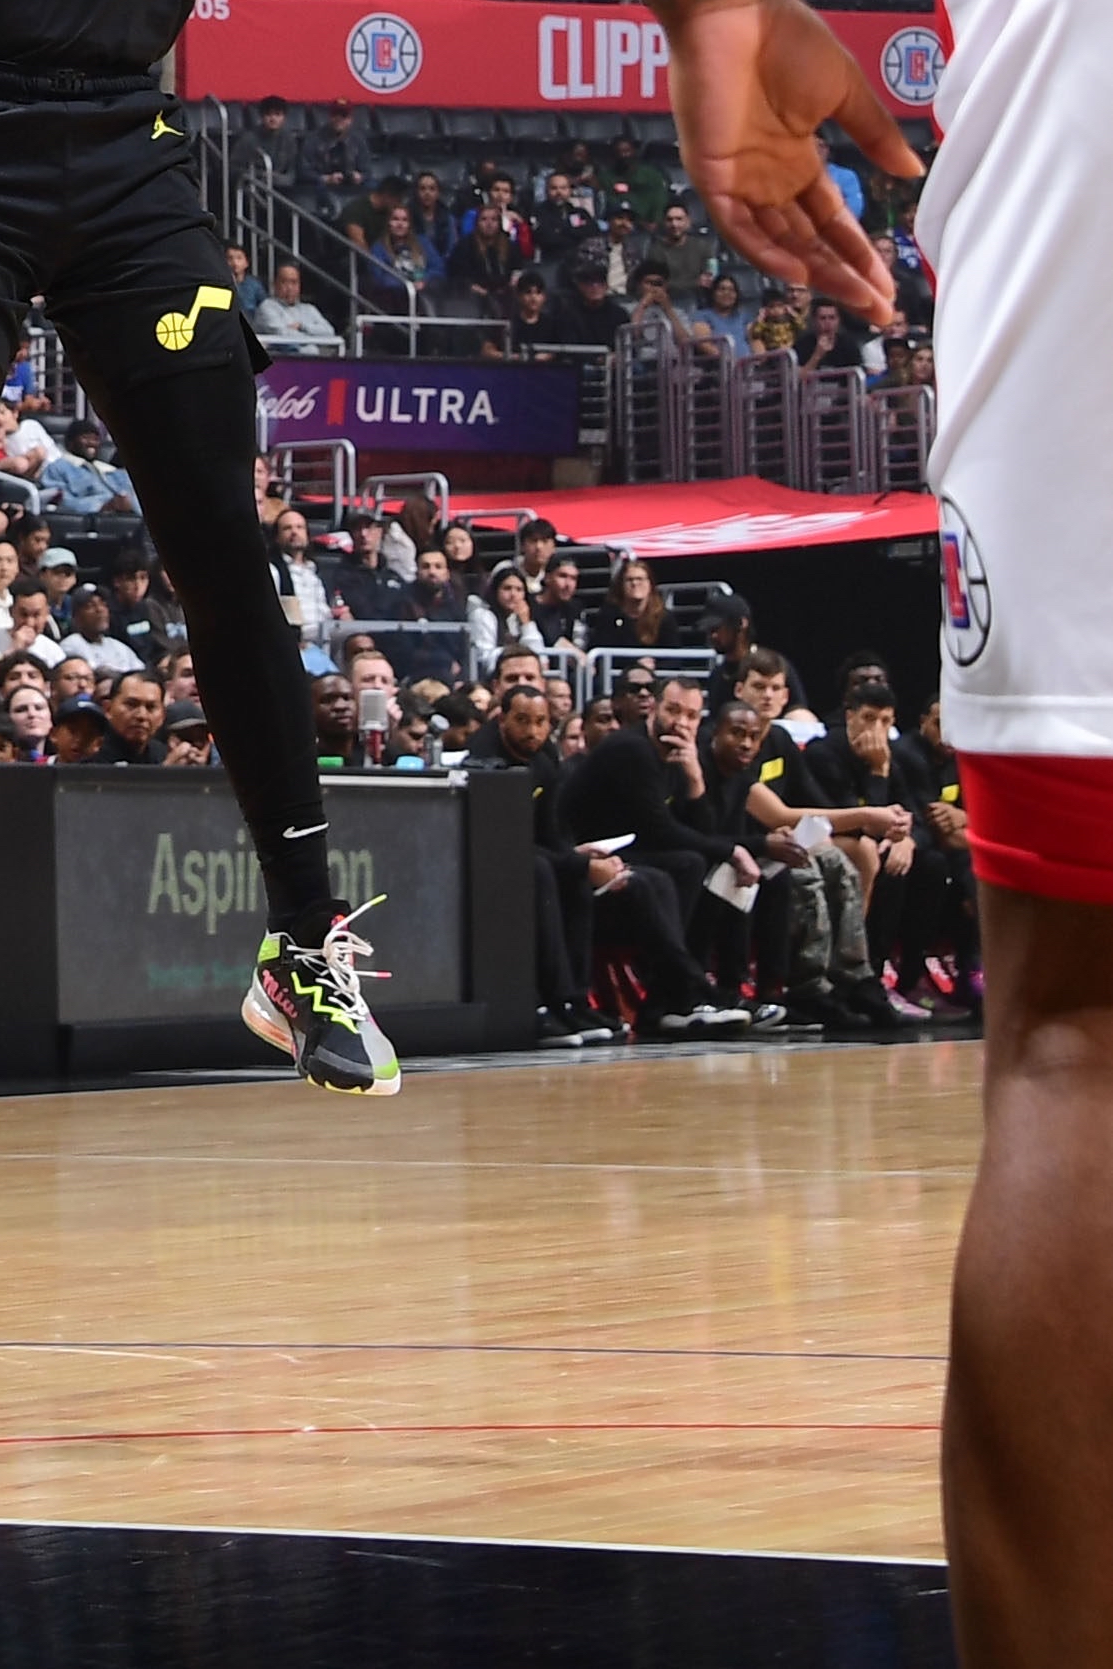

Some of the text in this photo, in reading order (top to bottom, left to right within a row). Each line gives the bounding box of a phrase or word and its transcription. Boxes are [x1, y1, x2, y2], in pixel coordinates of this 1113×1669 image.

[539, 14, 672, 100] CLIPP
[356, 386, 495, 425] ULTRA
[147, 829, 375, 935] Aspiron
